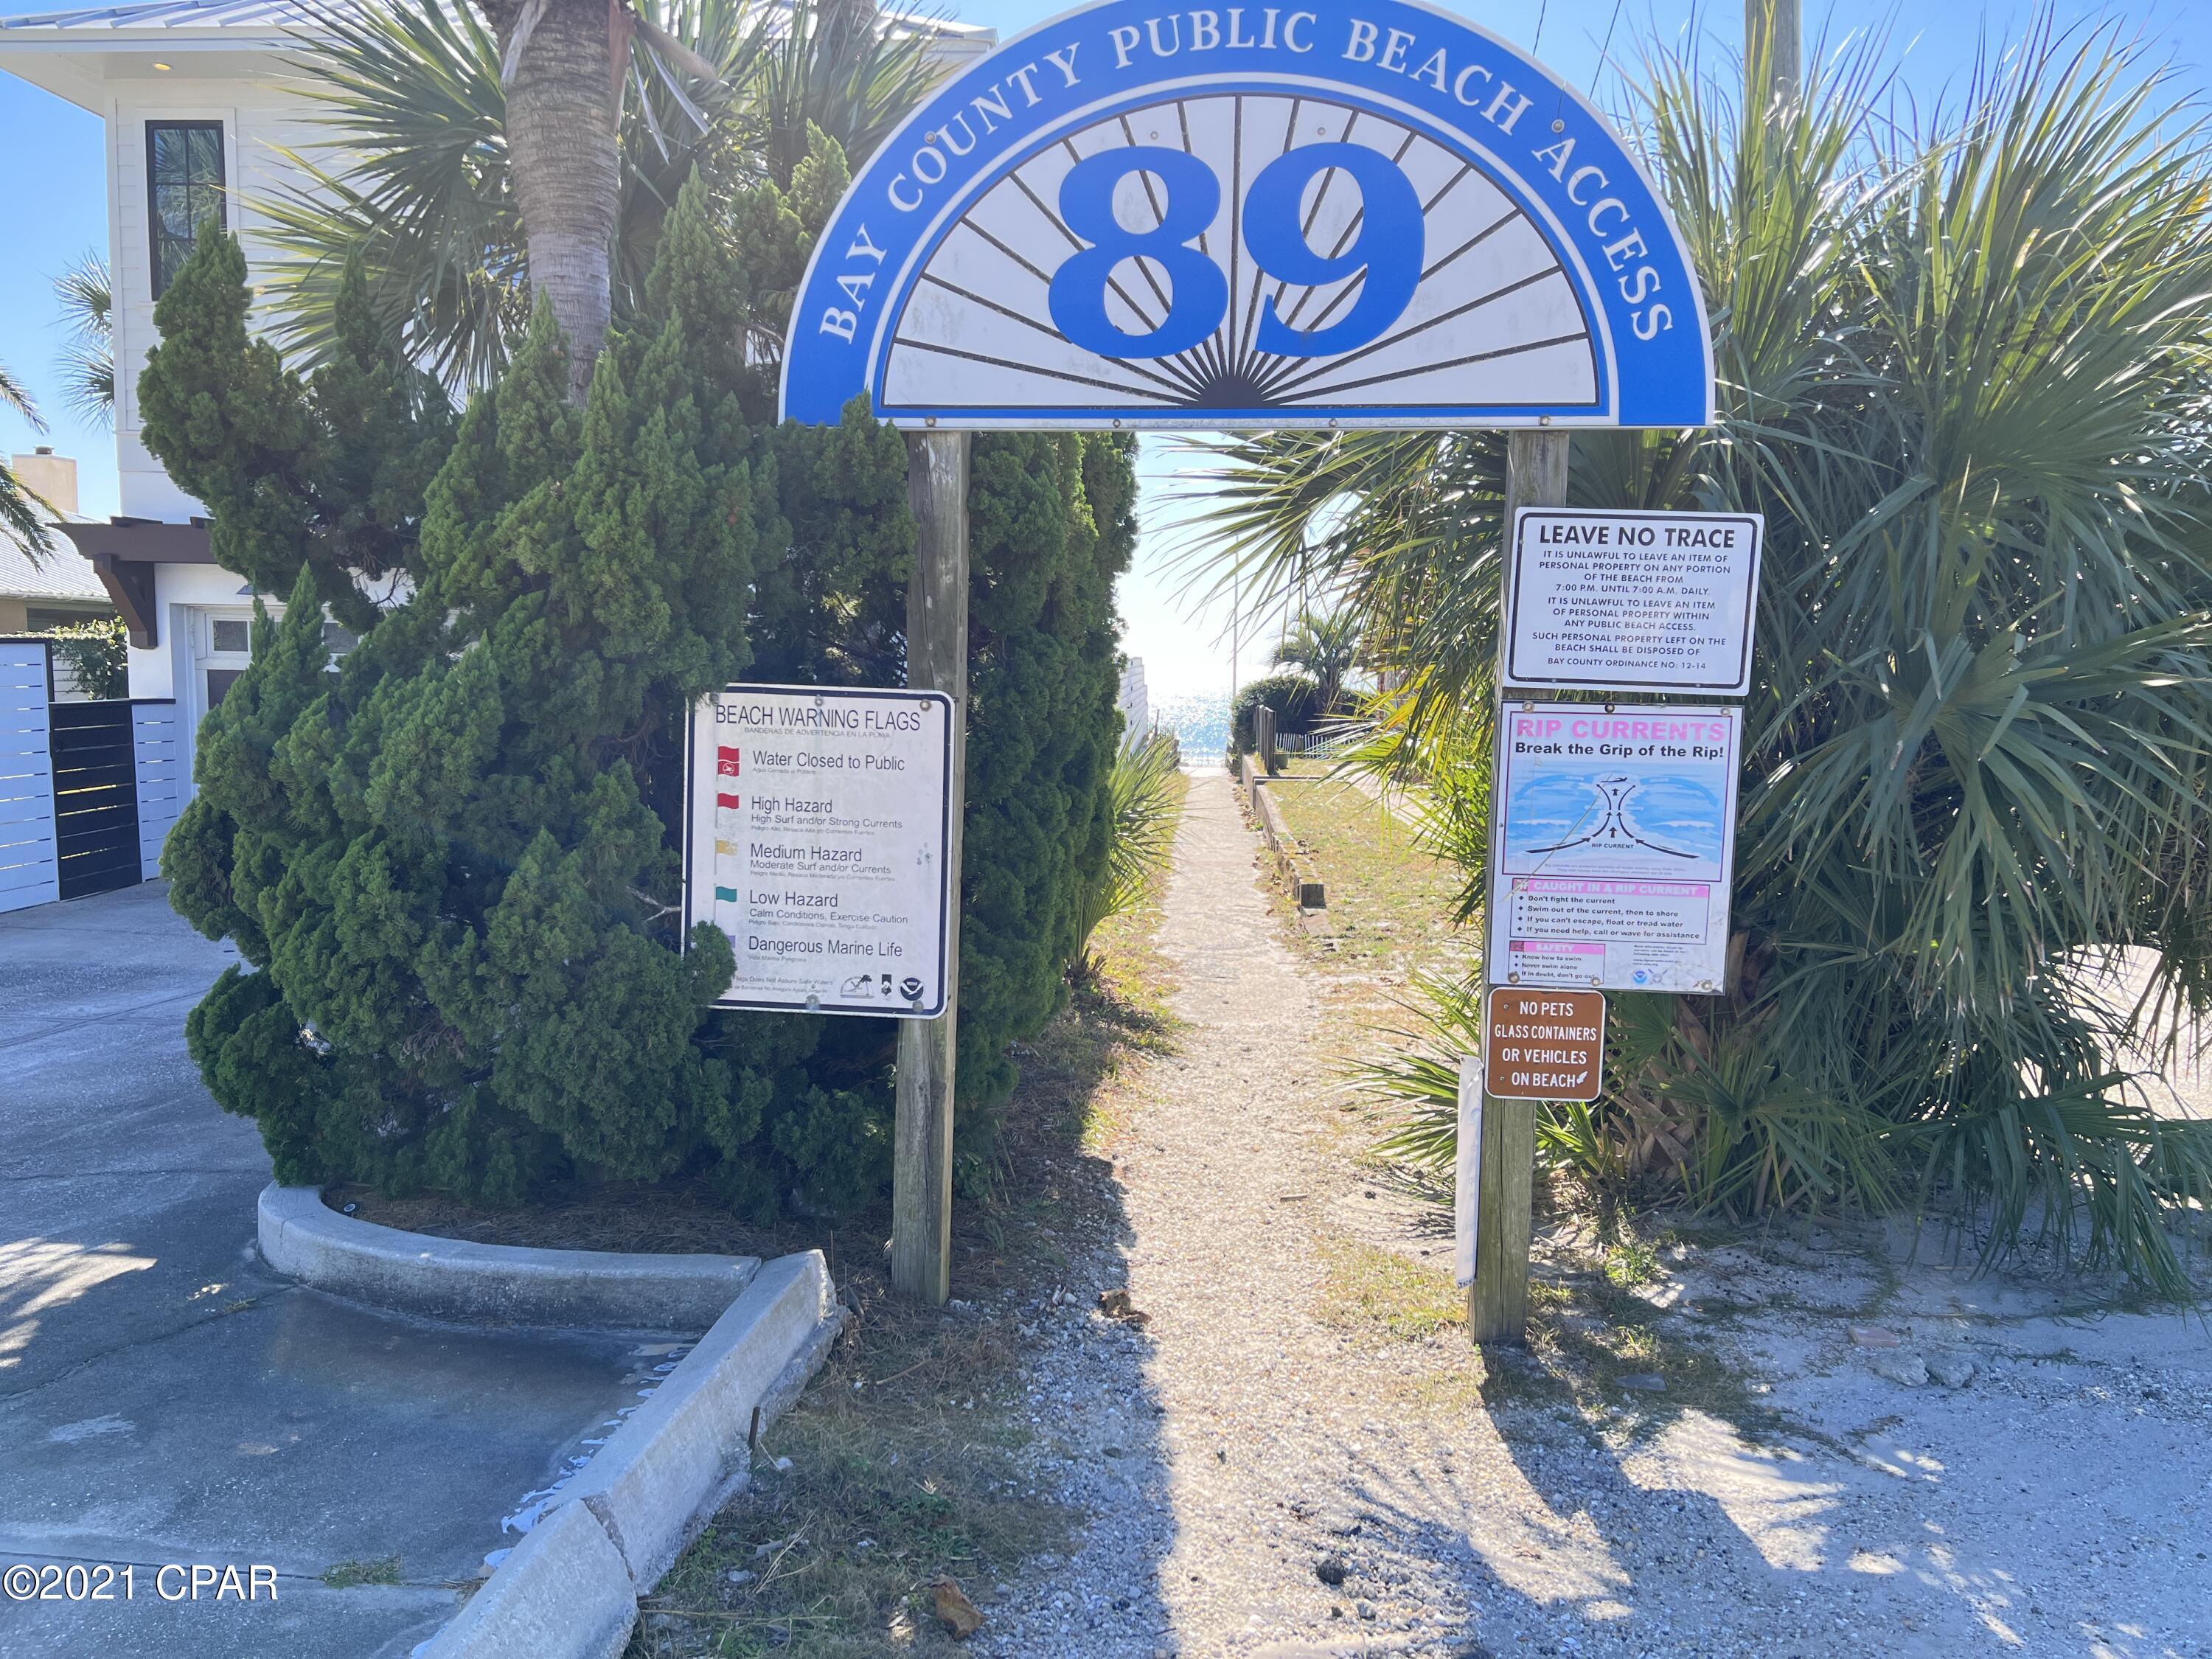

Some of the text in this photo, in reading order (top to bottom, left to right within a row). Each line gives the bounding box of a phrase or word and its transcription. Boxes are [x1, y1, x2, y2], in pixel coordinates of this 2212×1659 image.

[819, 8, 1673, 344] BAY COUNTY PUBLIC BEACH ACCESS
[1048, 142, 1425, 359] 89
[1540, 524, 1734, 548] LEAVE NO TRACE
[1566, 551, 1619, 559] UNLAWFUL
[1539, 561, 1589, 569] PERSONAL
[1592, 563, 1641, 571] PROPERTY
[1686, 565, 1730, 573] PORTION
[1600, 573, 1617, 581] THE
[1571, 597, 1624, 606] UNLAWFUL
[1643, 599, 1671, 608] LEAVE
[1568, 608, 1618, 616] PERSONAL
[1622, 610, 1670, 618] PROPERTY
[1587, 620, 1621, 628] PUBLIC
[1624, 621, 1655, 629] BEACH
[1658, 622, 1695, 630] ACCESS.
[1561, 633, 1611, 641] PERSONAL
[1615, 634, 1662, 643] PROPERTY
[1708, 637, 1725, 645] THE
[1589, 644, 1618, 653] SHALL
[1636, 646, 1683, 655] DISPOSED
[1605, 659, 1658, 667] ORDINANCE
[715, 705, 919, 731] BEACH WARNING FLAGS
[1517, 719, 1724, 741] RIP CURRENTS
[1515, 741, 1723, 760] Break the Grip of the Rip!
[752, 750, 905, 770] Water Closed to Public
[751, 796, 832, 814] High Hazard
[751, 814, 902, 828] High Surf and/or Strong Currents
[751, 843, 861, 861] Medium Hazard
[750, 859, 891, 874] Moderate Surf and/or Currents
[1534, 881, 1585, 891] CAUGHT
[1587, 883, 1600, 891] IN
[1603, 883, 1612, 893] A
[1615, 884, 1635, 893] RIP
[1638, 885, 1698, 895] CURRENT
[750, 889, 838, 907] Low Hazard
[749, 908, 908, 923] Calm Conditions, Exercise Caution
[748, 936, 902, 956] Dangerous Marine Life
[1536, 944, 1573, 952] SAFETY
[1520, 1001, 1573, 1016] NO PETS
[1495, 1023, 1596, 1040] GLASS CONTAINERS
[1502, 1048, 1587, 1064] OR VEHICLES
[1511, 1071, 1576, 1087] ON BEACH
